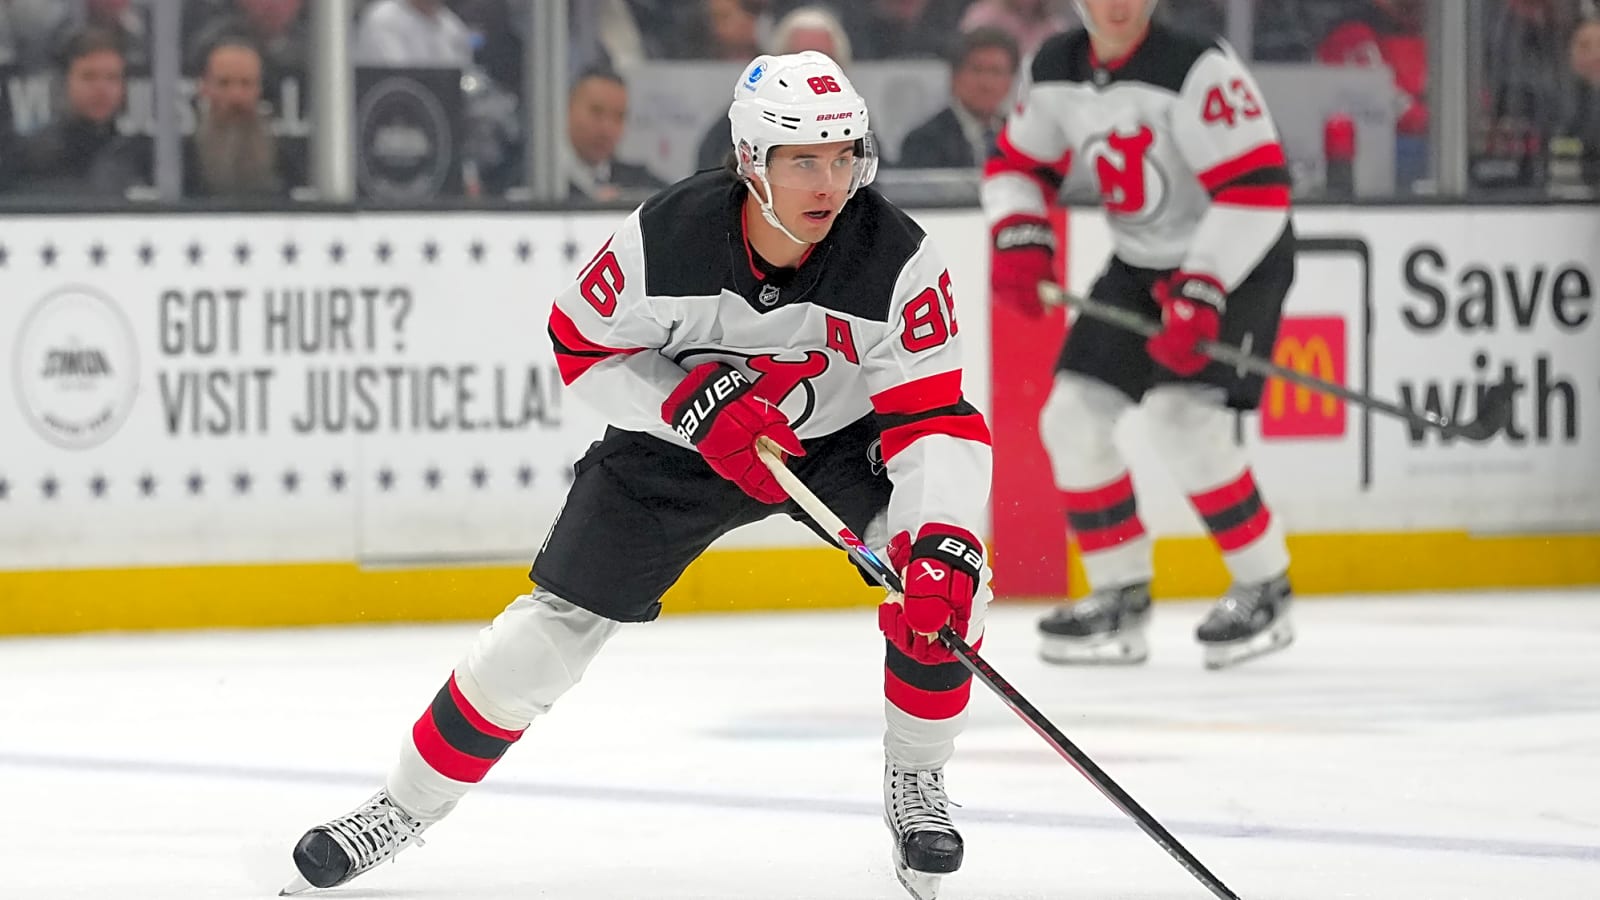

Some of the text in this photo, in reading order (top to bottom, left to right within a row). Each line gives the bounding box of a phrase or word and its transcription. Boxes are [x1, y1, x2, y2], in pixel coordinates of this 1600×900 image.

[807, 75, 841, 95] 86
[816, 112, 853, 122] BAUER
[1202, 79, 1262, 126] 43
[576, 232, 624, 317] 6
[1402, 248, 1592, 330] Save
[160, 288, 412, 355] GOT HURT?
[825, 313, 860, 365] A
[159, 364, 561, 435] VISIT JUSTICE.LA!
[676, 370, 748, 443] BAUER
[1401, 353, 1576, 441] with
